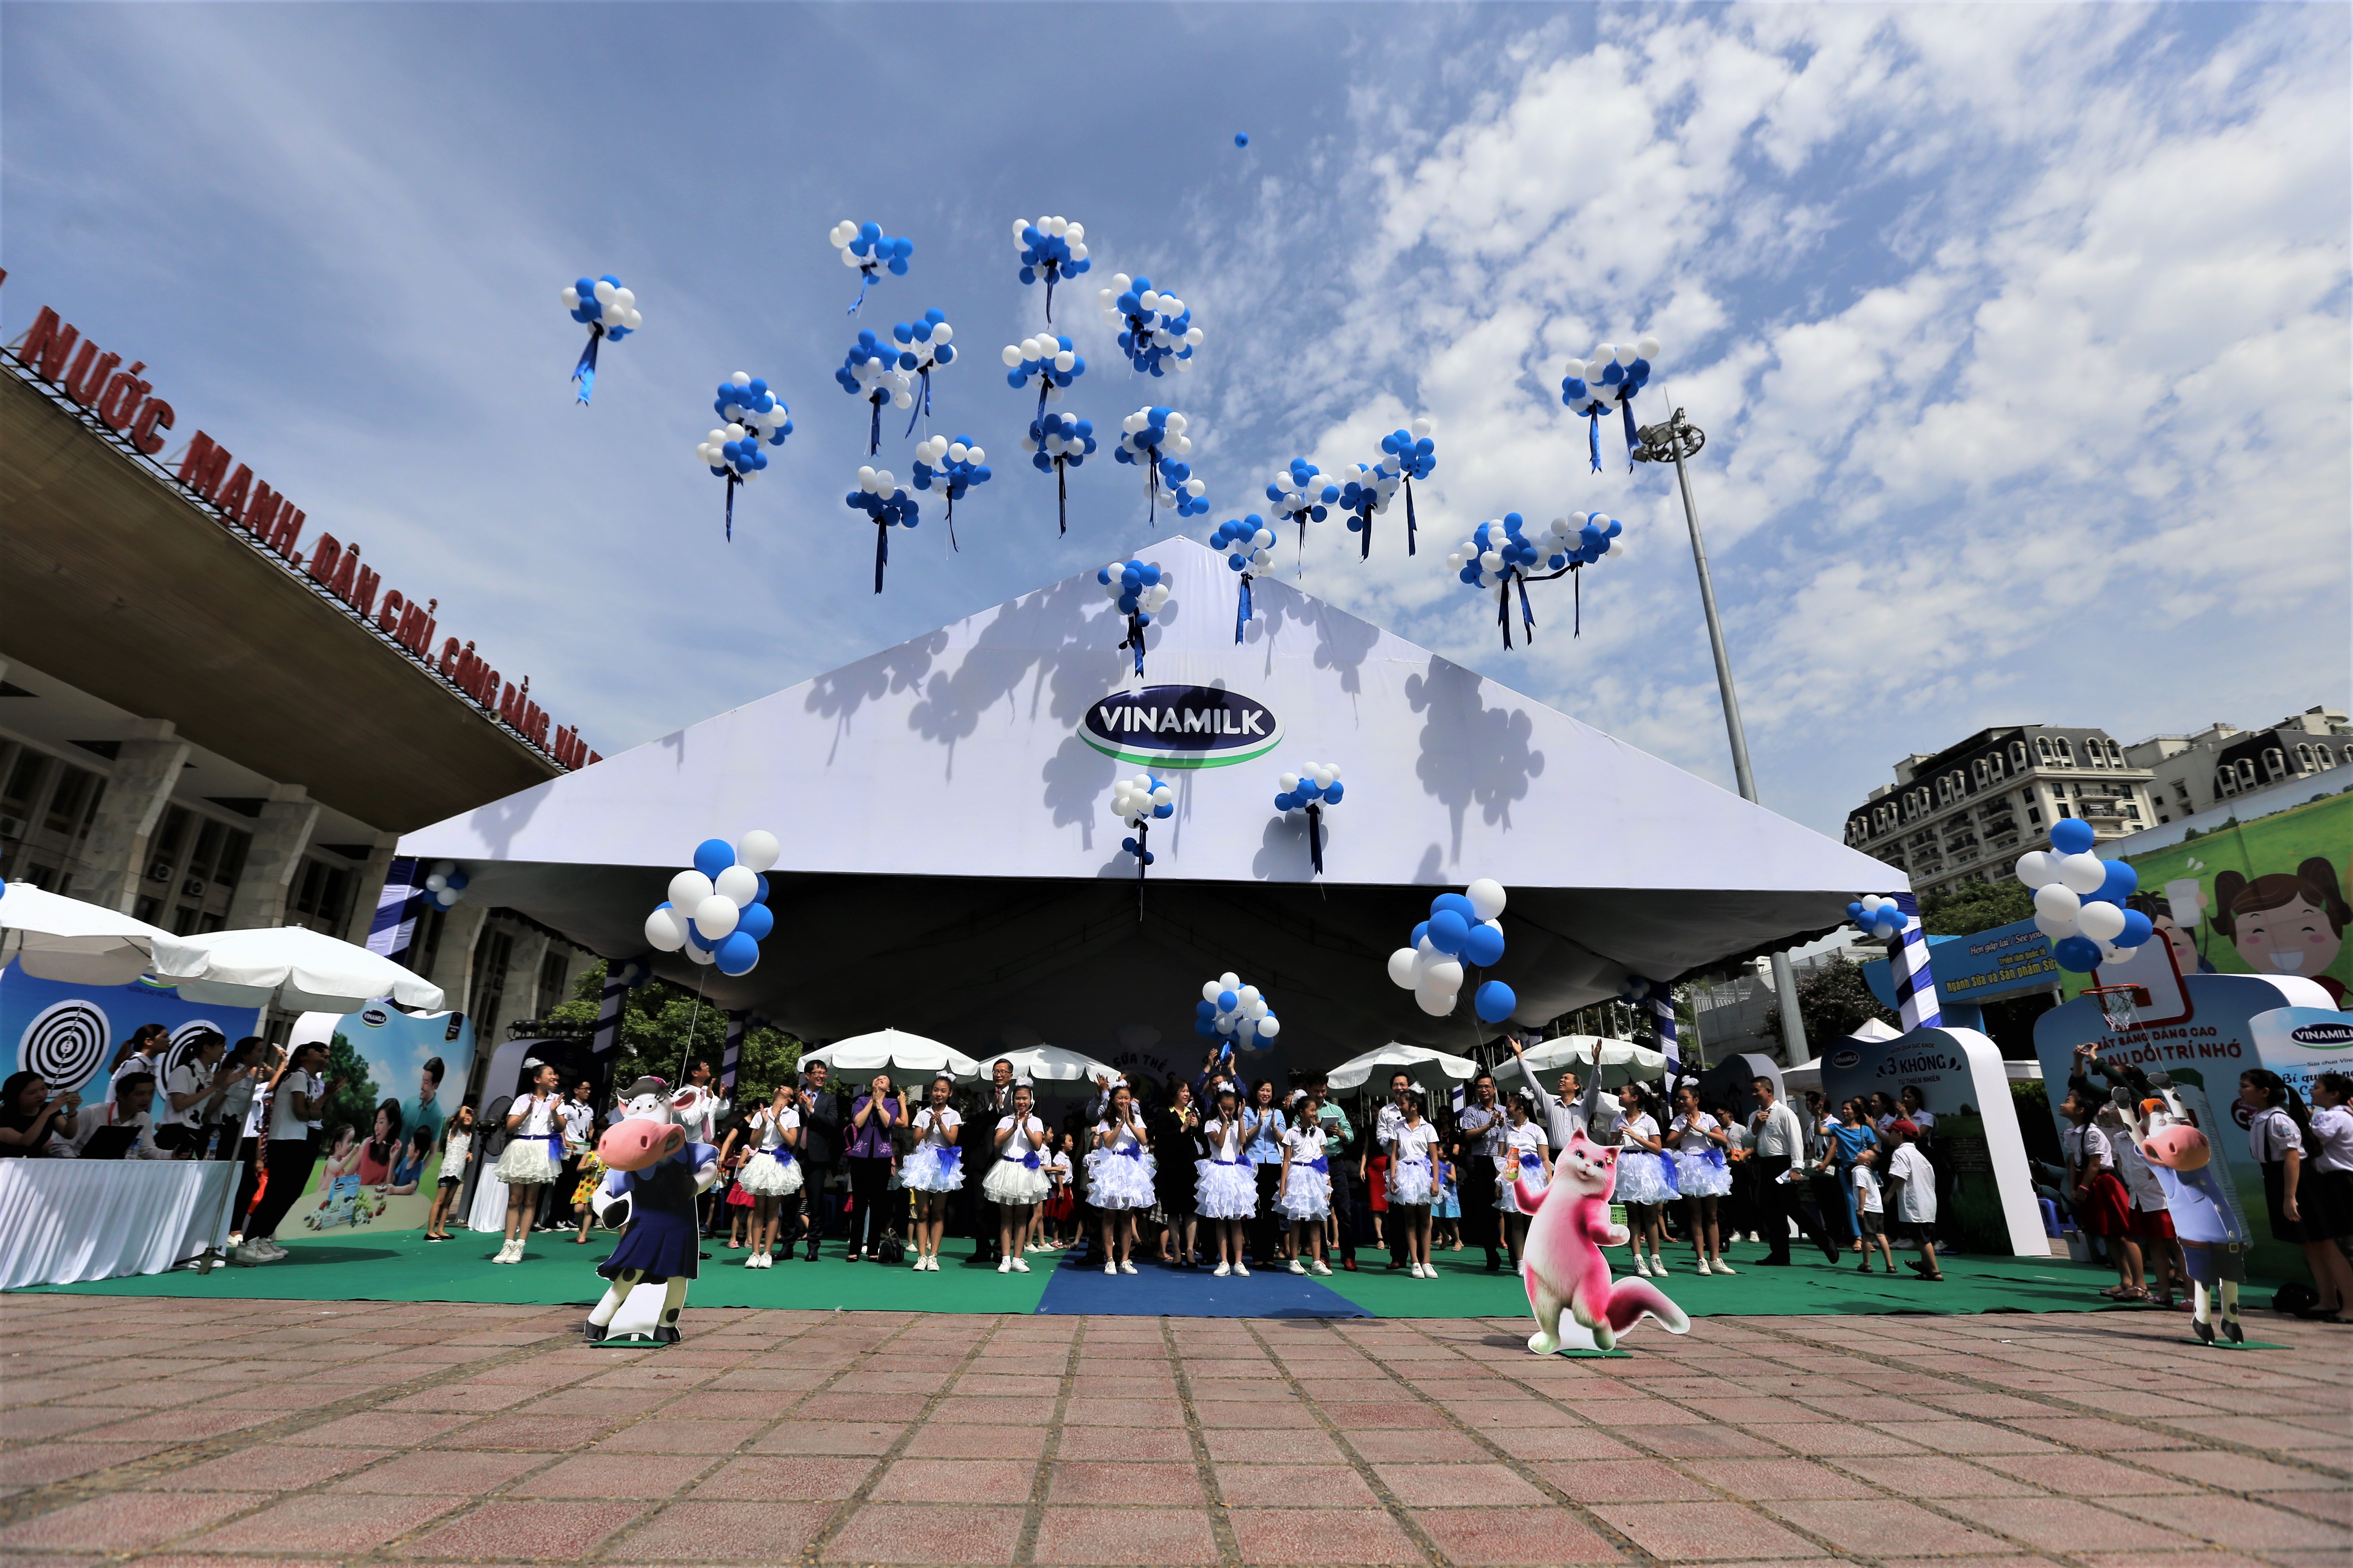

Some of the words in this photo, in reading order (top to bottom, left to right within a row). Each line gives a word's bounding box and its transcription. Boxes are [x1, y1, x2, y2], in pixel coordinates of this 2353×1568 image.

[18, 305, 175, 454] NƯỚC
[309, 532, 381, 618] DÂN
[439, 637, 500, 709] CÔNG
[553, 724, 588, 770] VĂN
[1100, 706, 1266, 735] VINAMILK
[1970, 945, 1984, 956] Hẹn
[1985, 941, 1998, 953] gặp
[1999, 937, 2009, 949] lại
[2015, 934, 2028, 943] See
[1946, 978, 1970, 992] Ngành
[1971, 974, 1987, 987] Sữa
[1987, 970, 1998, 983] và
[1999, 967, 2016, 981] Sản
[2017, 961, 2042, 979] phẩm
[364, 1013, 386, 1022] VINAMILK
[2118, 1032, 2149, 1046] SÁNG
[2153, 1027, 2187, 1041] DÁNG
[2190, 1026, 2218, 1037] CAO
[1834, 1054, 1858, 1064] VINAMILK
[2131, 1042, 2163, 1064] DỒI
[2163, 1040, 2195, 1060] TRÍ
[2197, 1038, 2242, 1059] NHỚ
[1143, 1054, 1169, 1073] THẾ
[1886, 1056, 1897, 1075] 3
[1899, 1052, 1947, 1074] KHÔNG
[1905, 1075, 1922, 1084] THIÊN
[1923, 1073, 1941, 1083] NHIÊN
